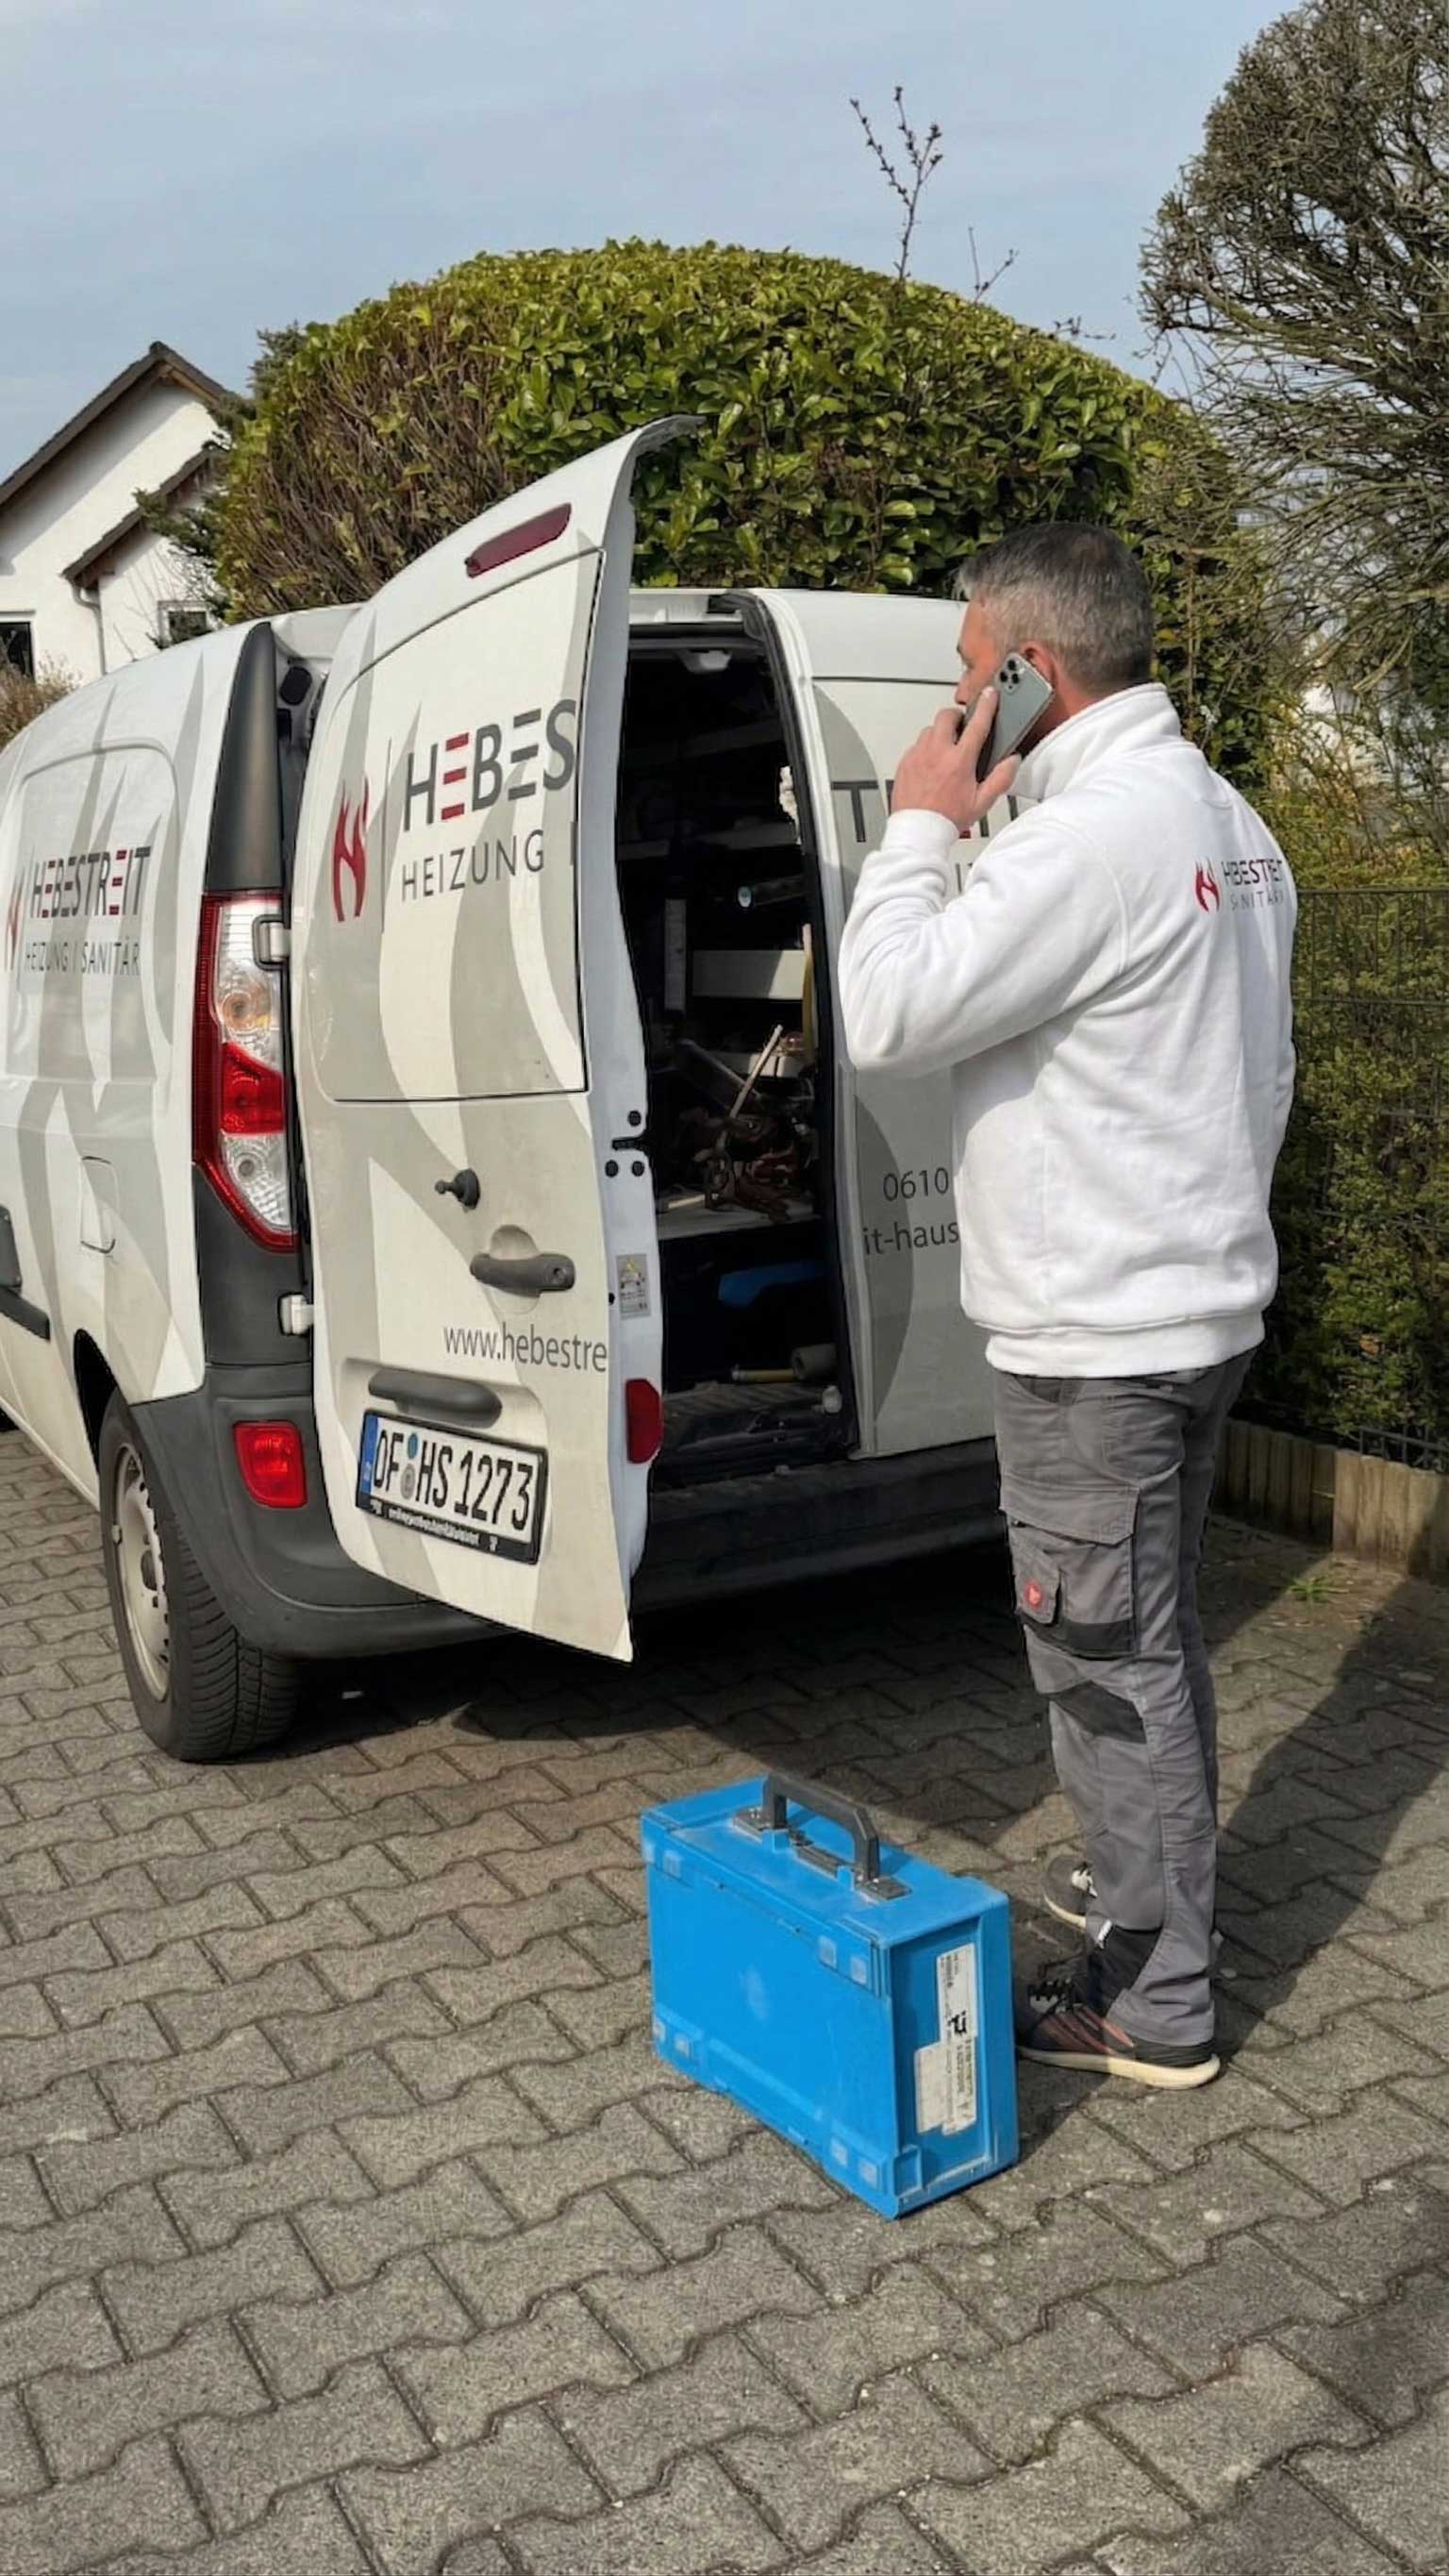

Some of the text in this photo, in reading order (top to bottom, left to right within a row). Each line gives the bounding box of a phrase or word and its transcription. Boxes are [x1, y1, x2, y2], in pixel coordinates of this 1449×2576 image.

[404, 698, 576, 832] HEBES
[30, 845, 151, 919] HEBESTREIT
[402, 828, 544, 902] HEIZUNG
[882, 1166, 949, 1201] 0610
[862, 1221, 960, 1256] it-haus
[443, 1321, 608, 1373] www.hebestre
[374, 1429, 404, 1492] OF
[415, 1439, 453, 1509] HS
[454, 1449, 534, 1531] 1273
